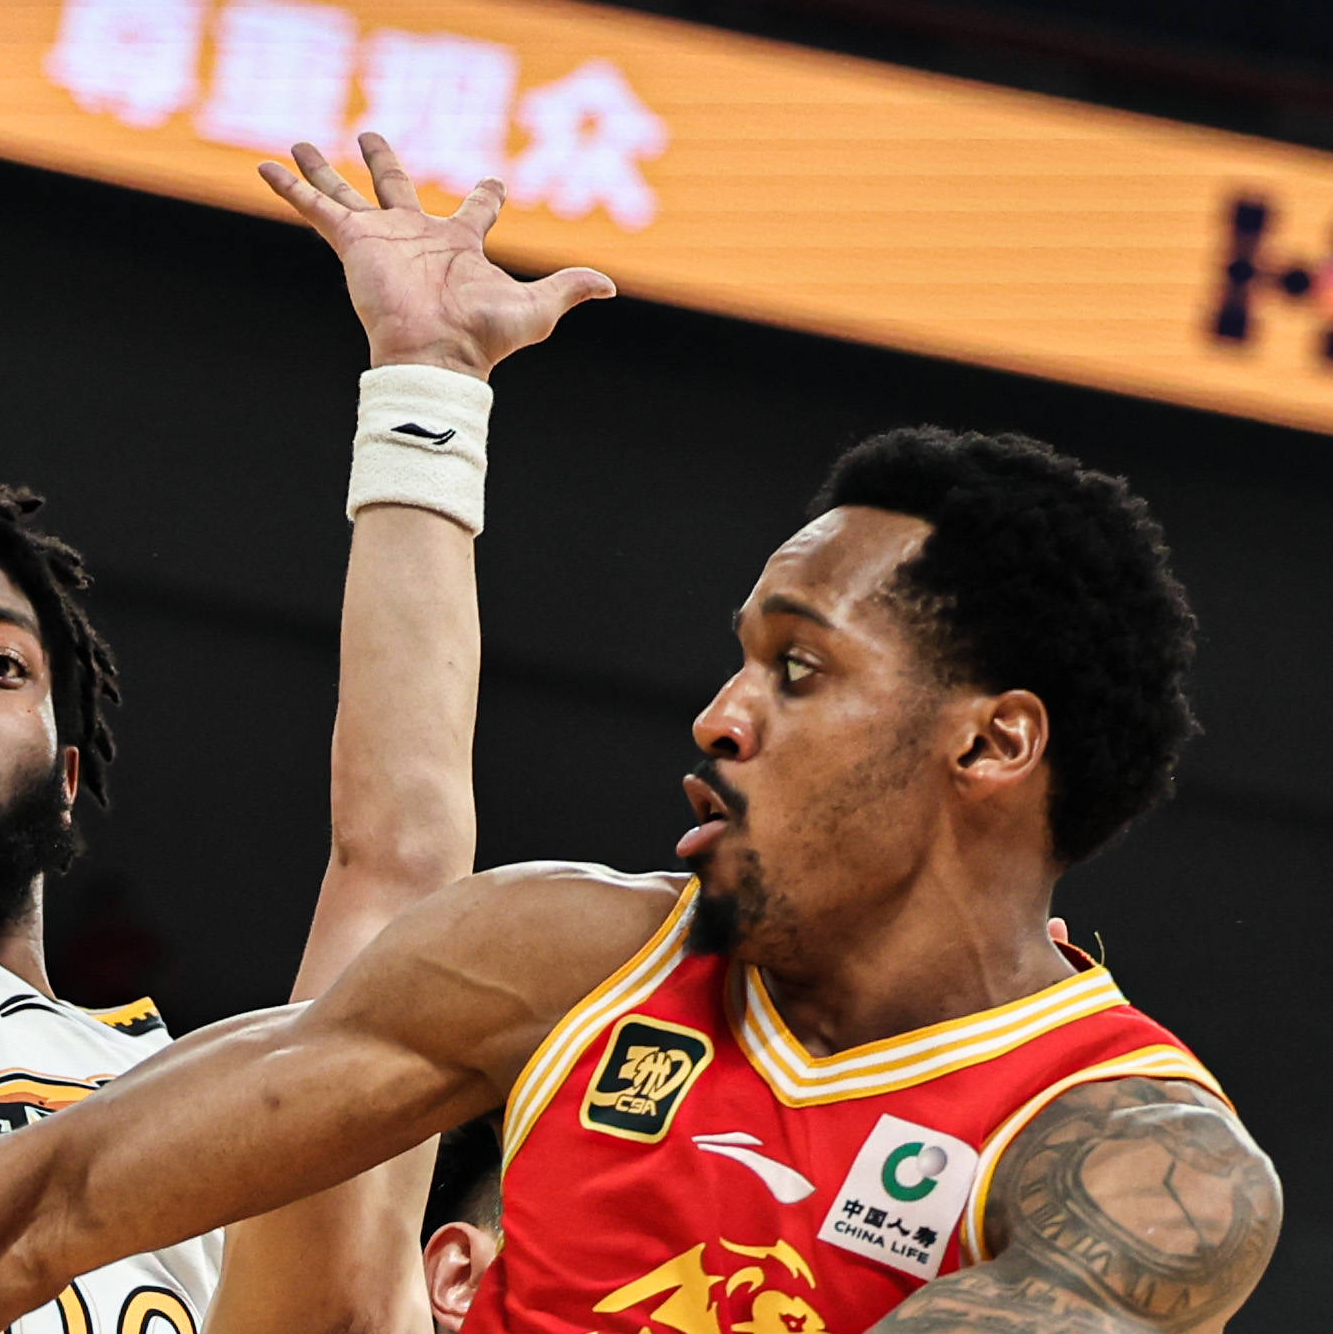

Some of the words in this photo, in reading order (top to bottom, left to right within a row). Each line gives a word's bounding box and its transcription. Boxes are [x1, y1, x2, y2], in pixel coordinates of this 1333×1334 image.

[614, 1093, 658, 1118] CBA
[834, 1220, 885, 1248] CHINA
[890, 1241, 930, 1265] LIFE
[842, 1199, 938, 1249] 中国人寿
